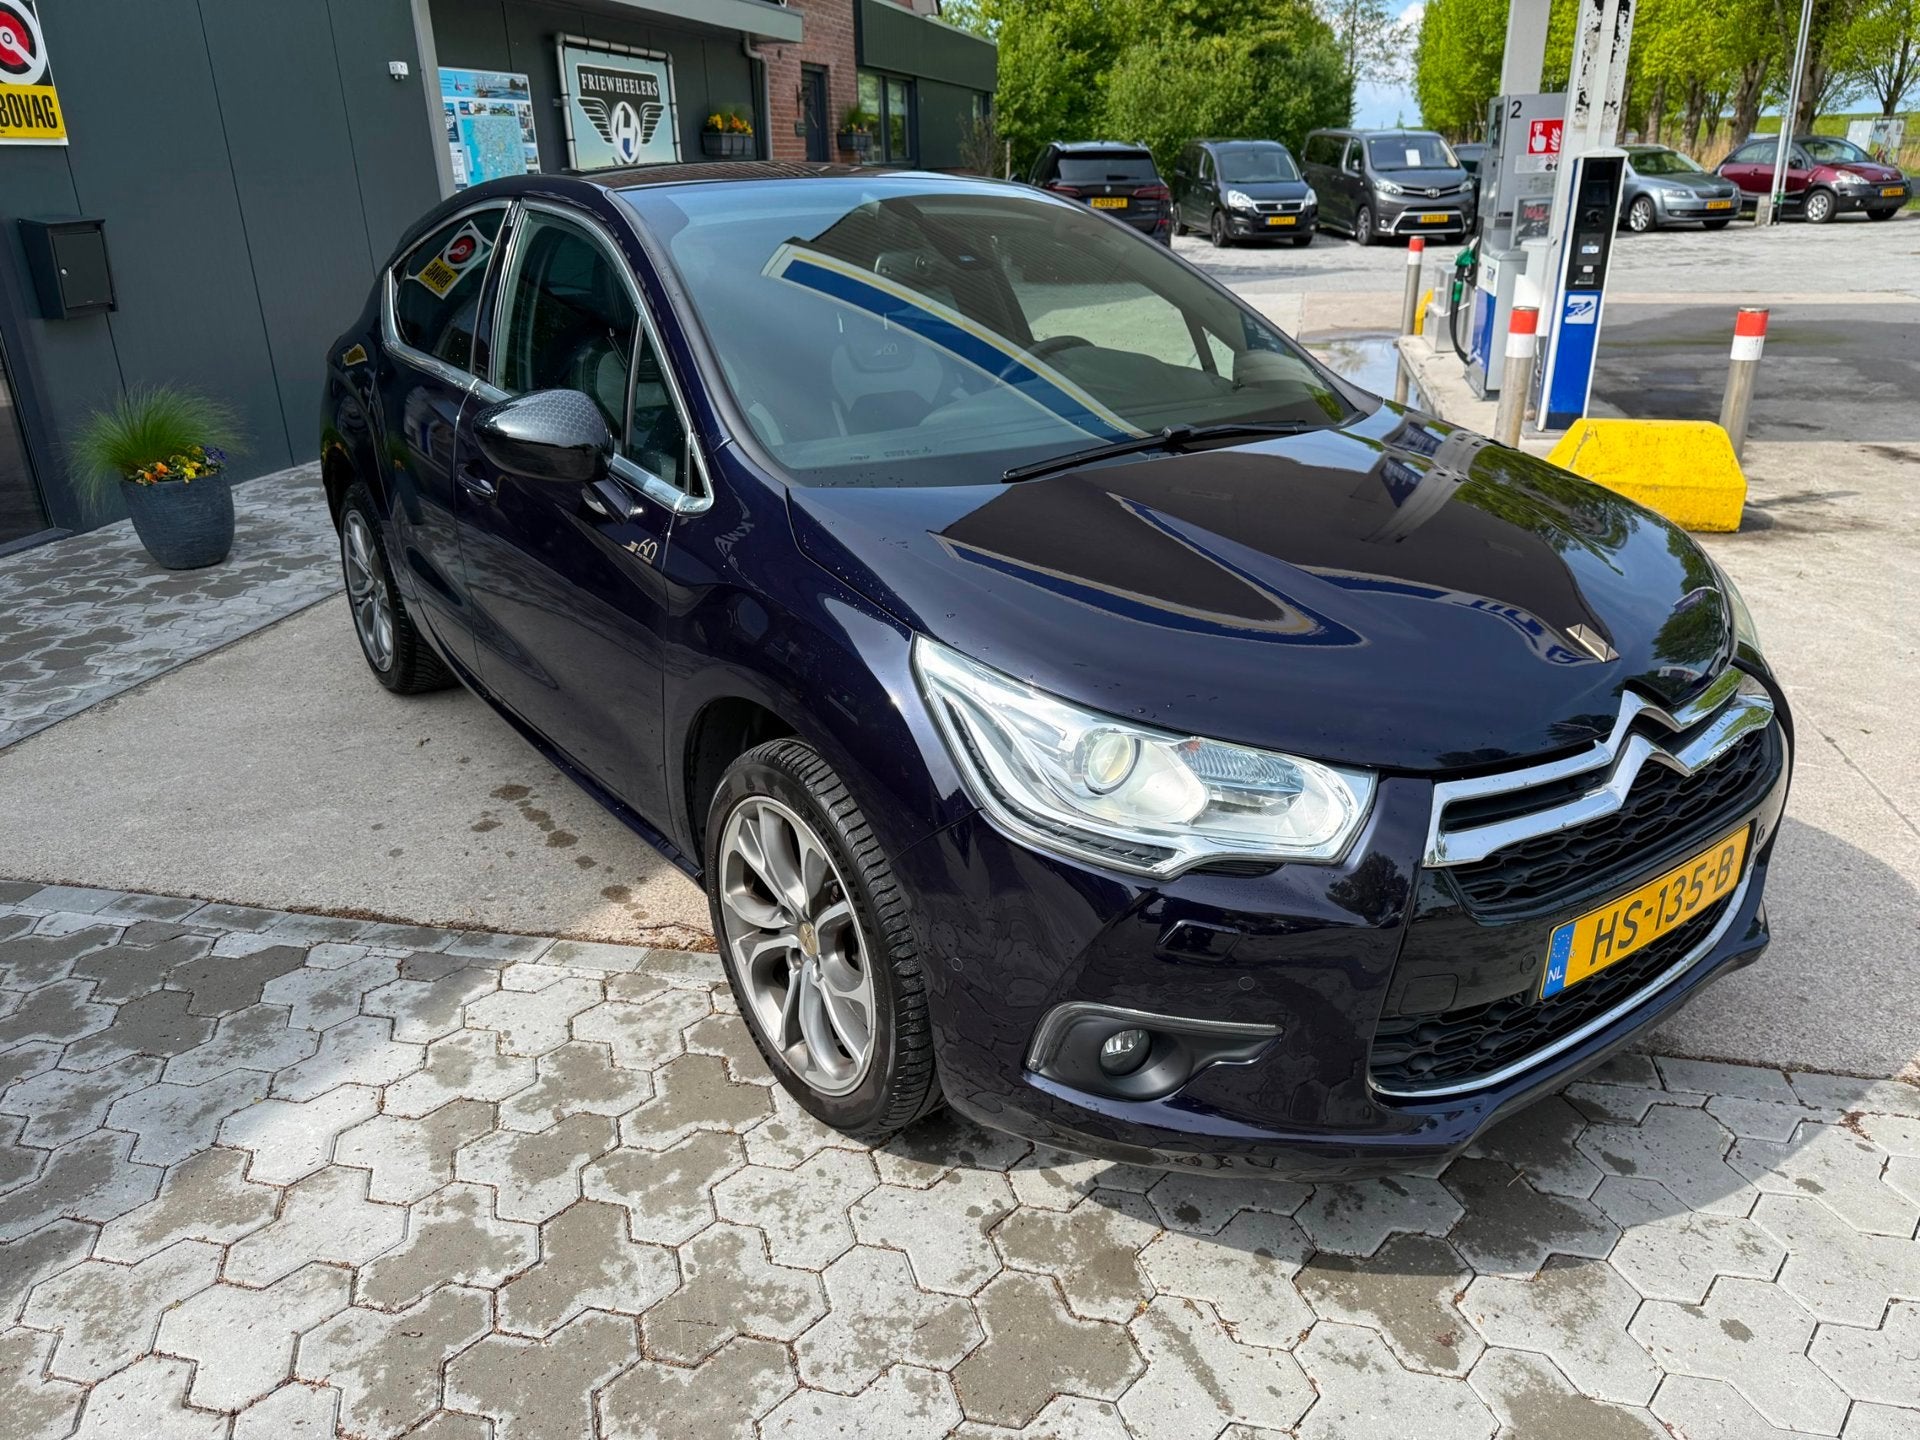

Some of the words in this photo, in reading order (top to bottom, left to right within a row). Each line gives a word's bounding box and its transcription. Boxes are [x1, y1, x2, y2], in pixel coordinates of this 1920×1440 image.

[581, 73, 658, 97] FRIEWHEELERS
[1510, 100, 1522, 119] 2
[1589, 844, 1735, 967] HS-135-B
[1547, 964, 1564, 985] NL
